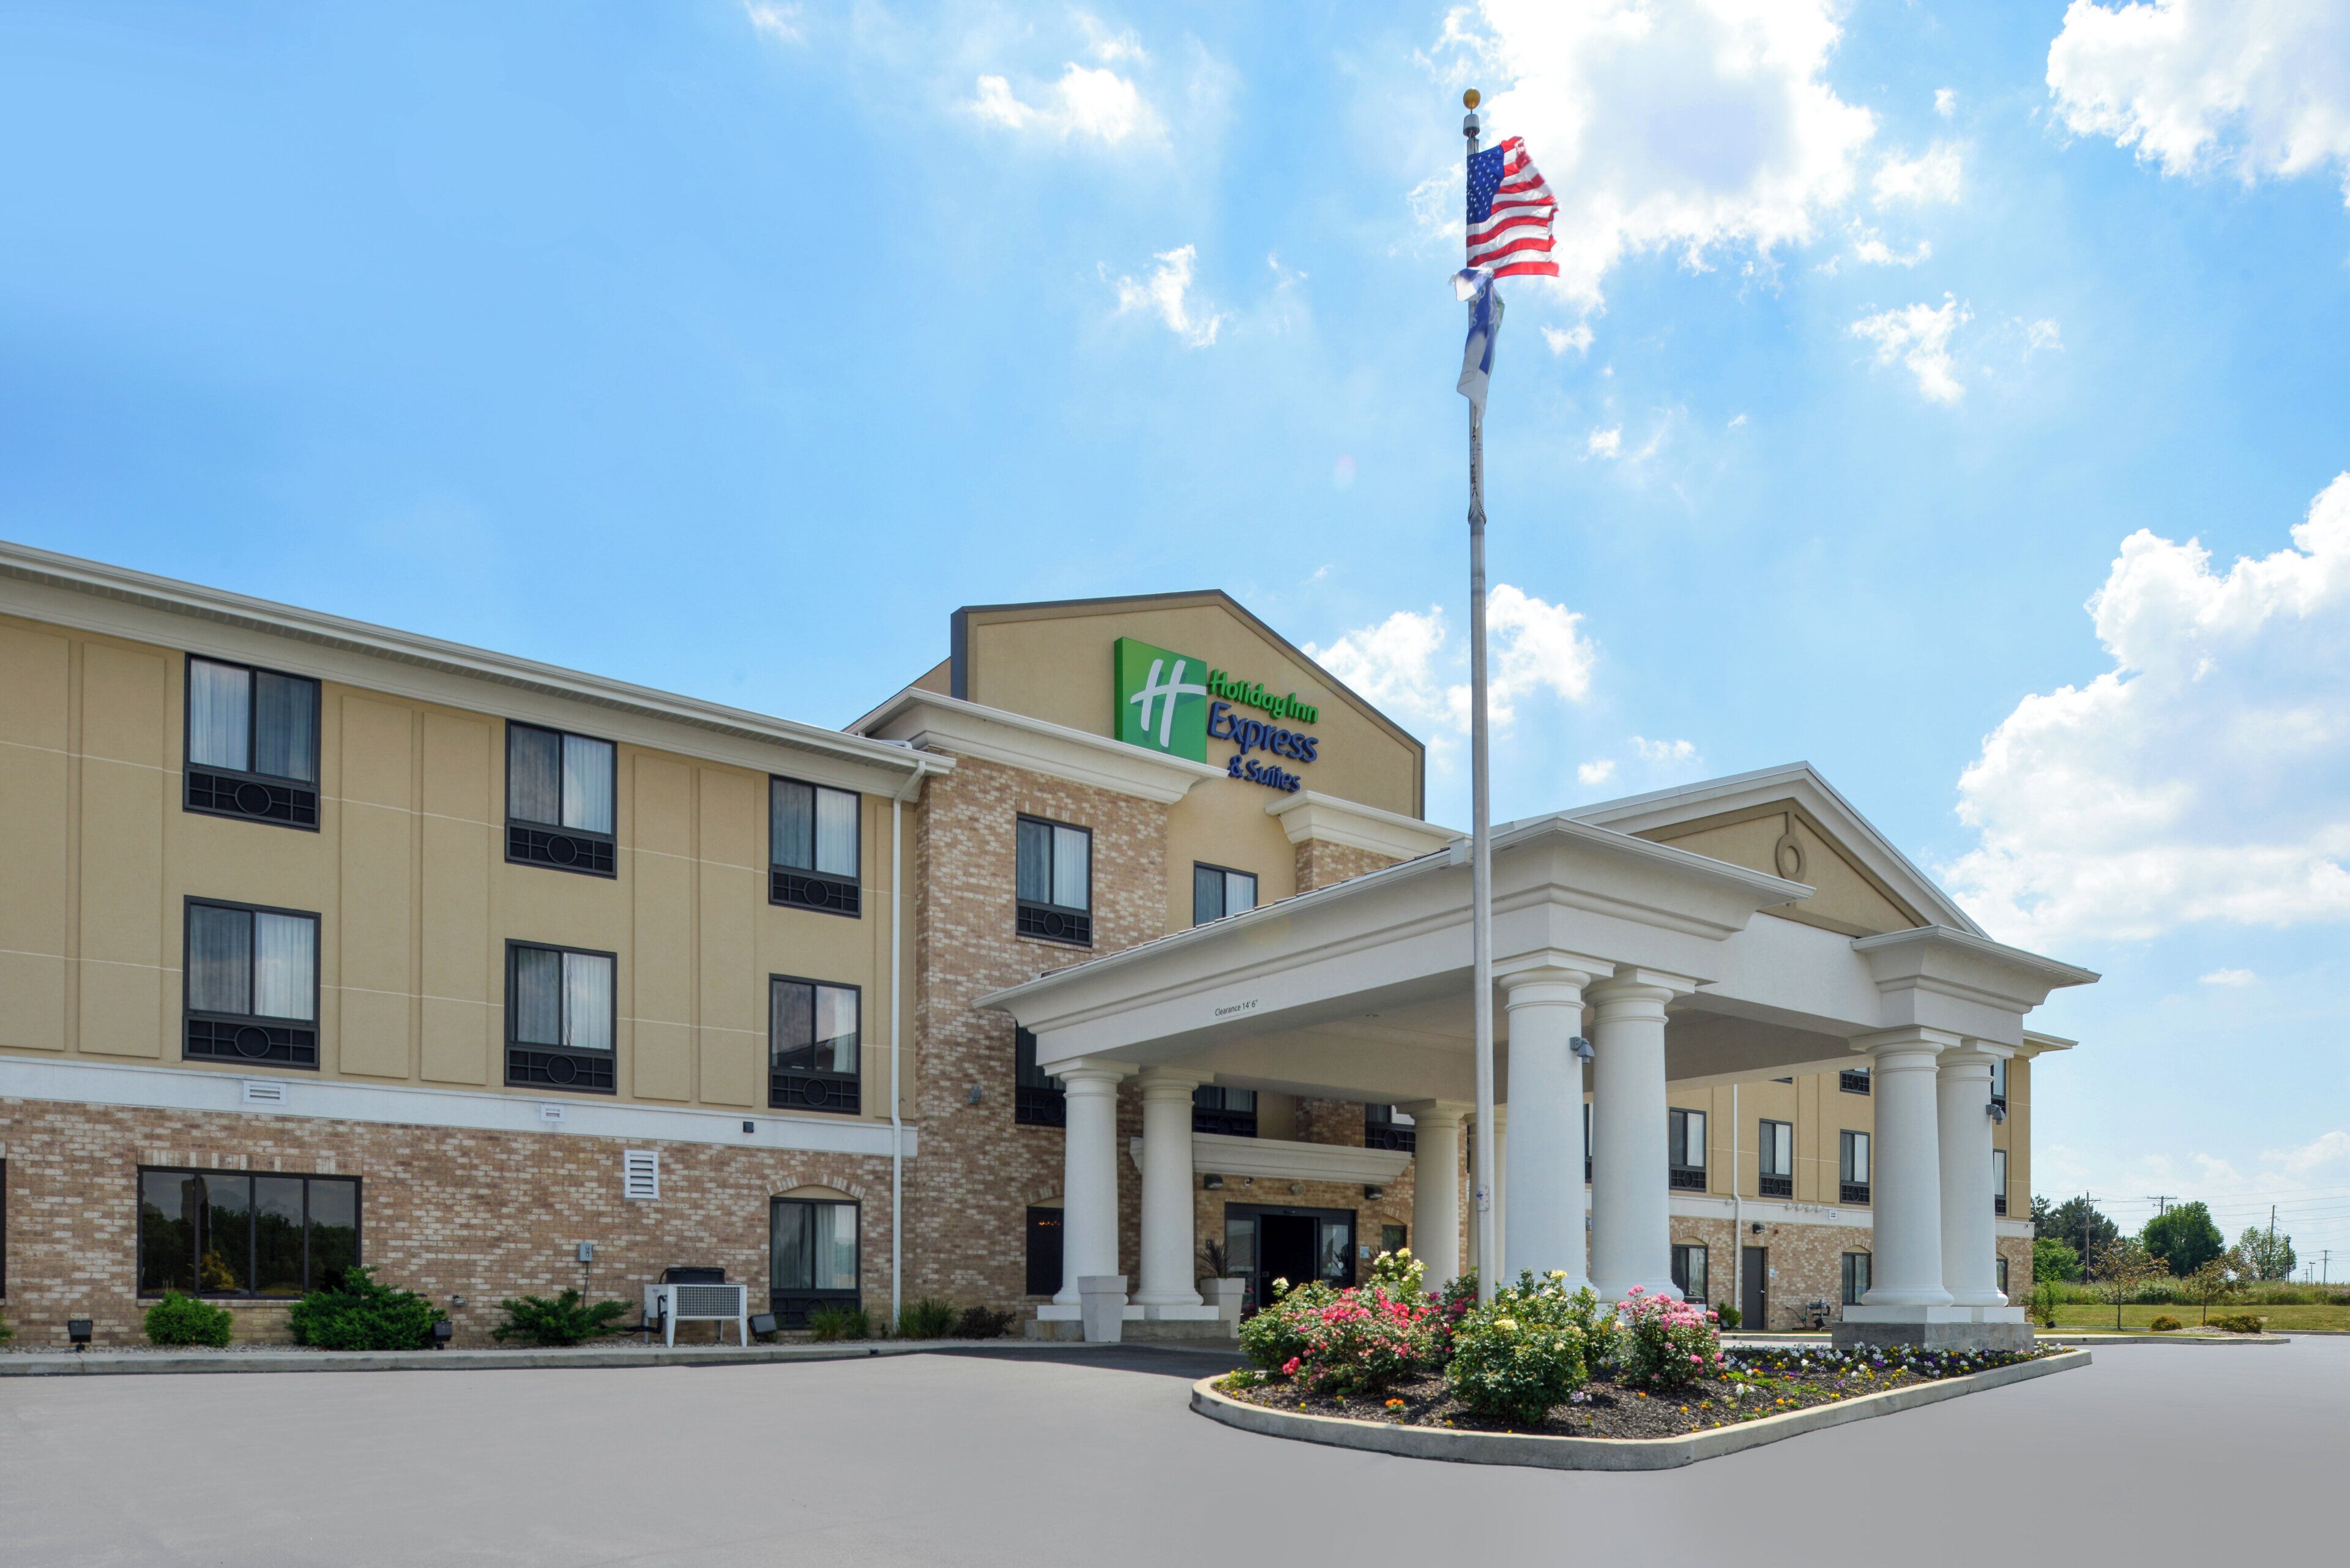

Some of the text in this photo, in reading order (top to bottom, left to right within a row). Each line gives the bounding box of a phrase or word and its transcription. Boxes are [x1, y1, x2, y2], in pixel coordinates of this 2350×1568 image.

[1208, 669, 1319, 724] Holiday Inn
[1207, 701, 1319, 763] Express
[1228, 754, 1301, 793] & Suites
[1215, 1005, 1241, 1016] Clearance
